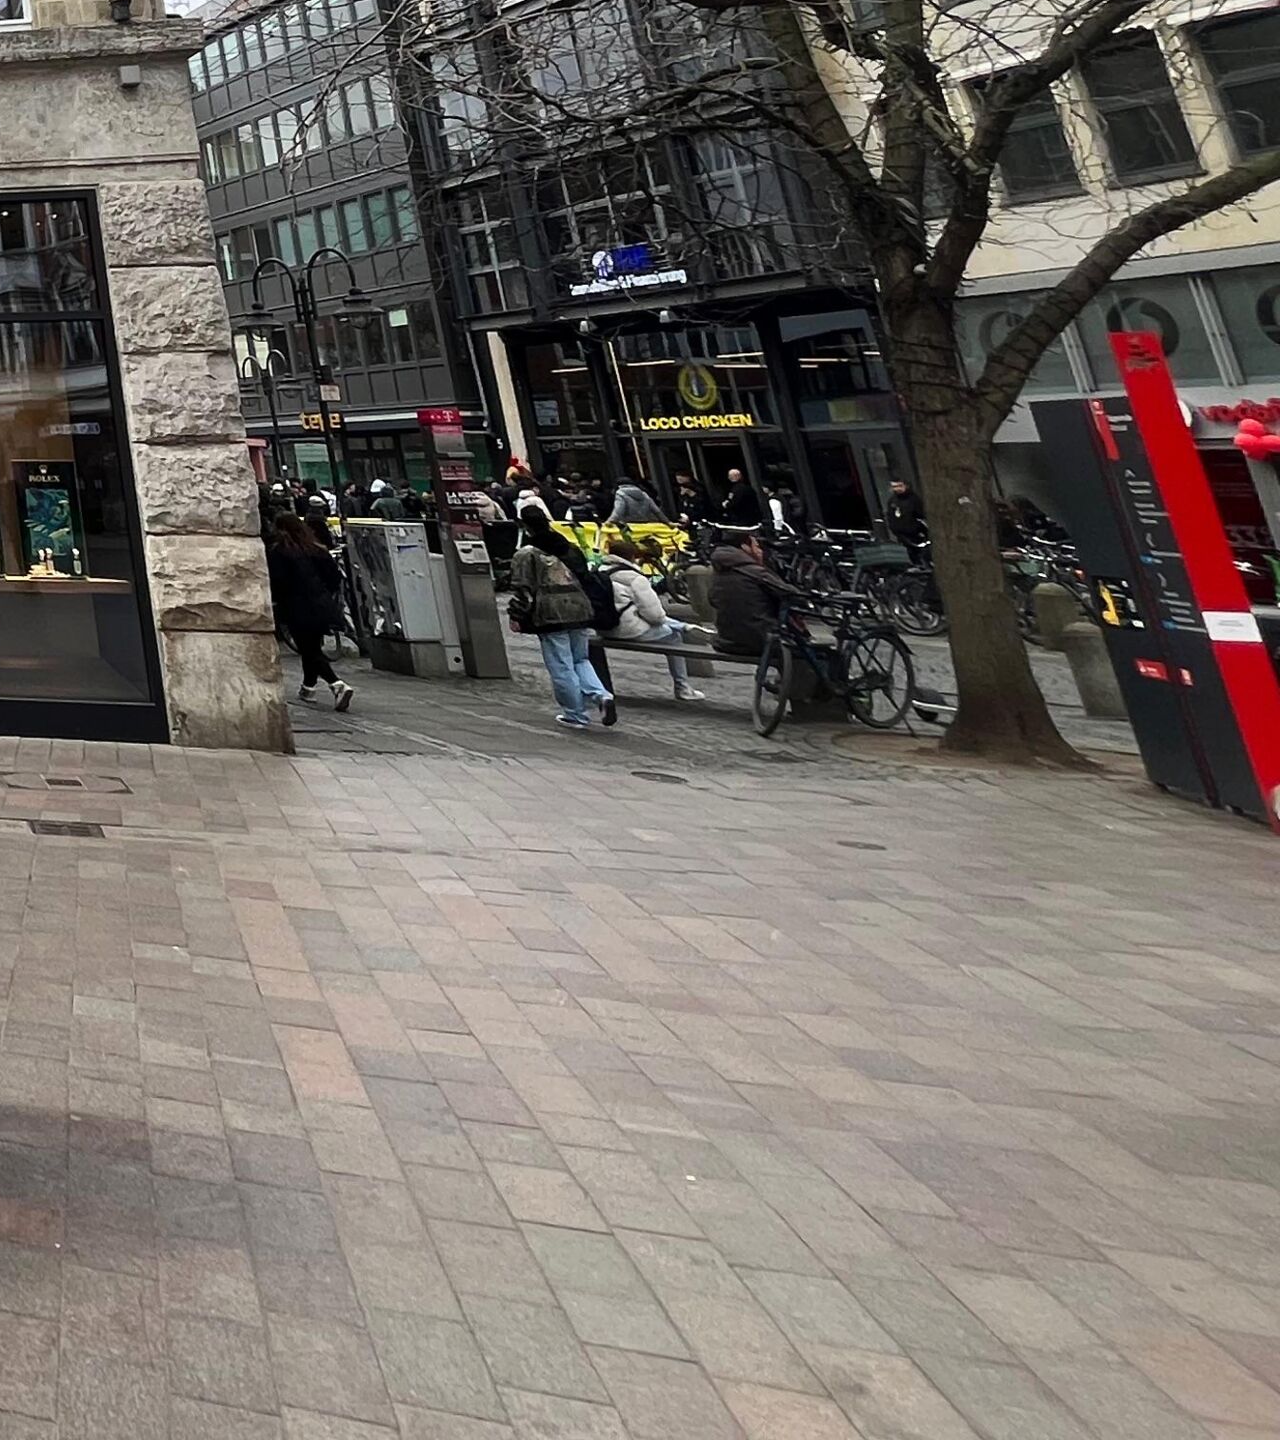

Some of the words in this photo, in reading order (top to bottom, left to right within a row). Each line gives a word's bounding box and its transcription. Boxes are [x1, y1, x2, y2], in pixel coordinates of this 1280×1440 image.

[640, 417, 680, 430] LOCO
[683, 414, 753, 429] CHICKEN
[28, 474, 60, 482] ROLEX
